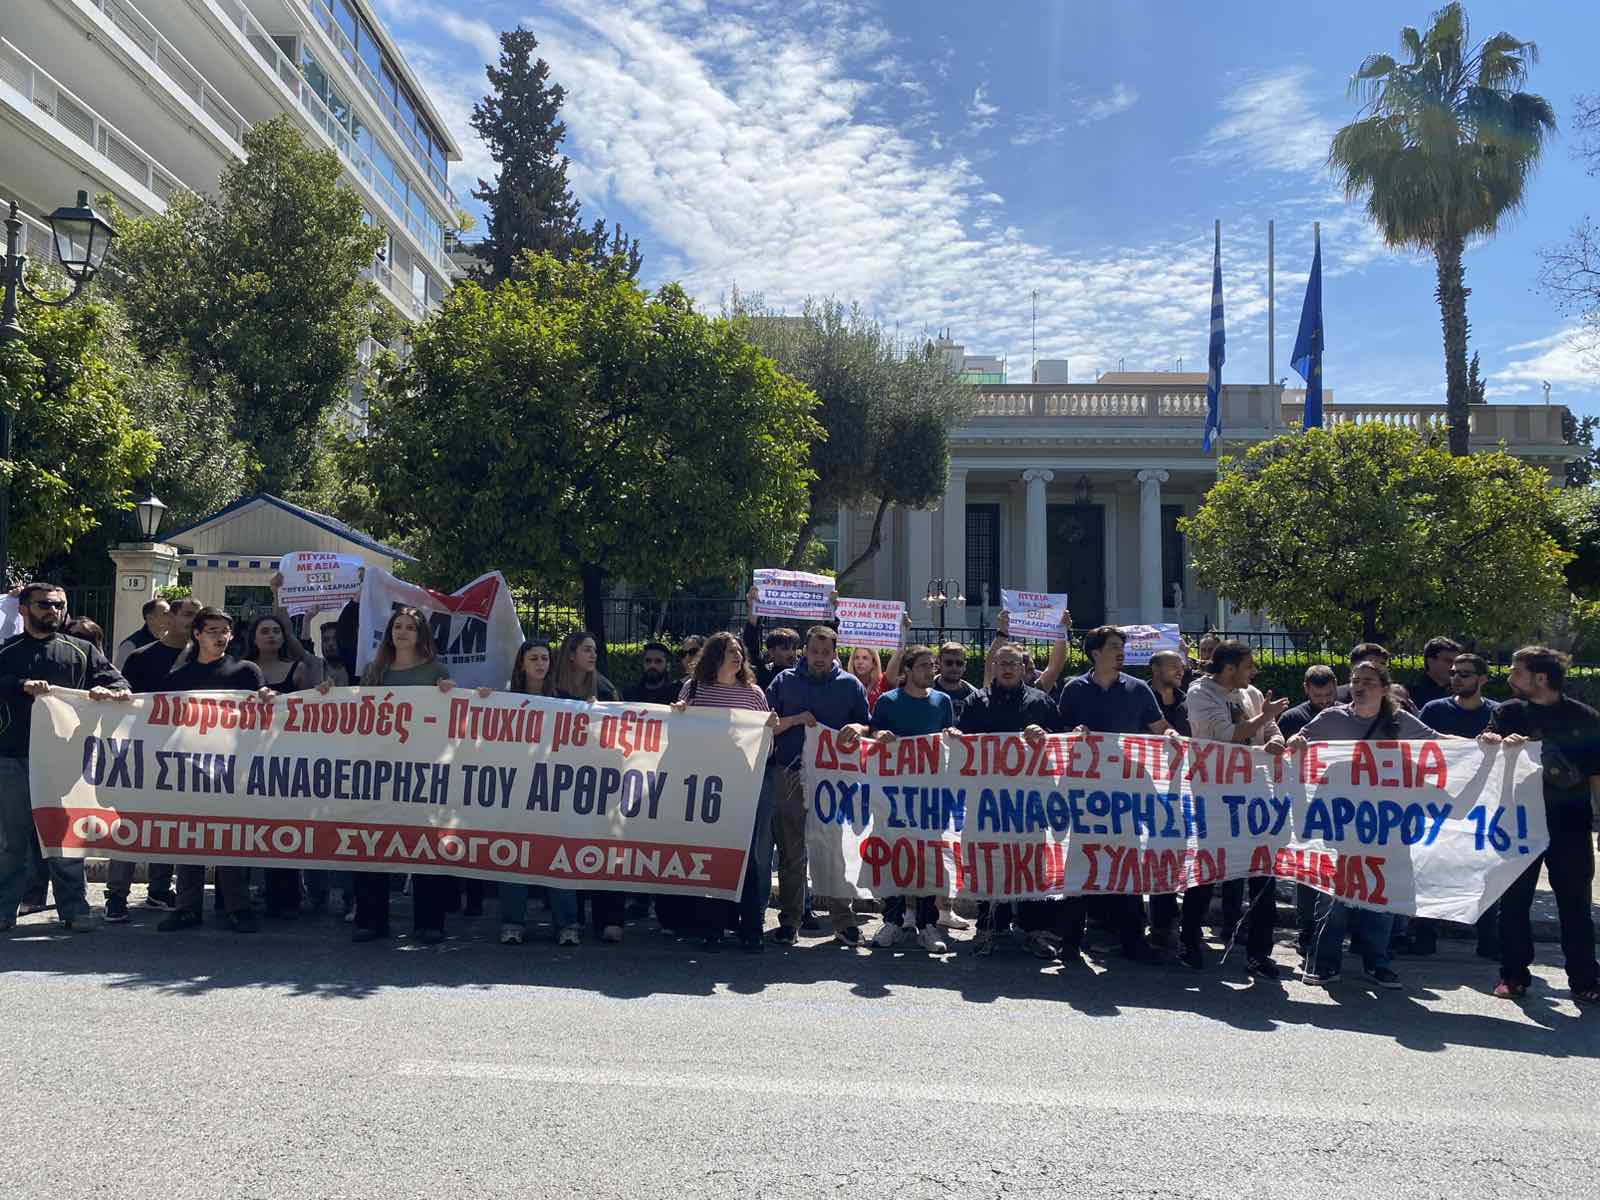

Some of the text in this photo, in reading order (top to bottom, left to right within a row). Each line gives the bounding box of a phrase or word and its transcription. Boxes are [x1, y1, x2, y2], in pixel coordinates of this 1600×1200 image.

[296, 561, 340, 571] ΜΕ ΑΞΙΑ
[299, 553, 337, 561] ΠΤΥΧΙΑ
[309, 573, 329, 583] ΟΧΙ
[840, 609, 857, 617] ΟΧΙ
[859, 610, 873, 618] ΜΕ
[284, 691, 413, 745] Σπουδές
[424, 716, 437, 724] -
[448, 698, 545, 745] Πτυχία
[552, 711, 590, 753] με
[600, 709, 663, 759] αξία
[82, 735, 724, 824] ΟΧΙ ΣΤΗΝ ΑΝΑΘΕΩΡΗΣΗ ΤΟΥ ΑΡΘΡΟΥ 16
[814, 729, 941, 777] ΔΩΡΕΑΝ
[1350, 740, 1448, 790] ΑΞΙΑ
[72, 814, 713, 881] ΦΟΙΤΗΤΙΚΟΙ ΣΥΛΛΟΓΟΙ ΑΘΗΝΑΣ
[814, 779, 1530, 855] ΟΧΙ ΣΤΗΝ ΑΝΑΘΕΩΡΗΣΗ ΤΟΥ ΑΡΘΡΟΥ 16!
[859, 836, 1066, 896] ΦΟΙΤΗΤΙΚΟΙ
[1248, 844, 1389, 905] ΑΘΗΝΑΣ
